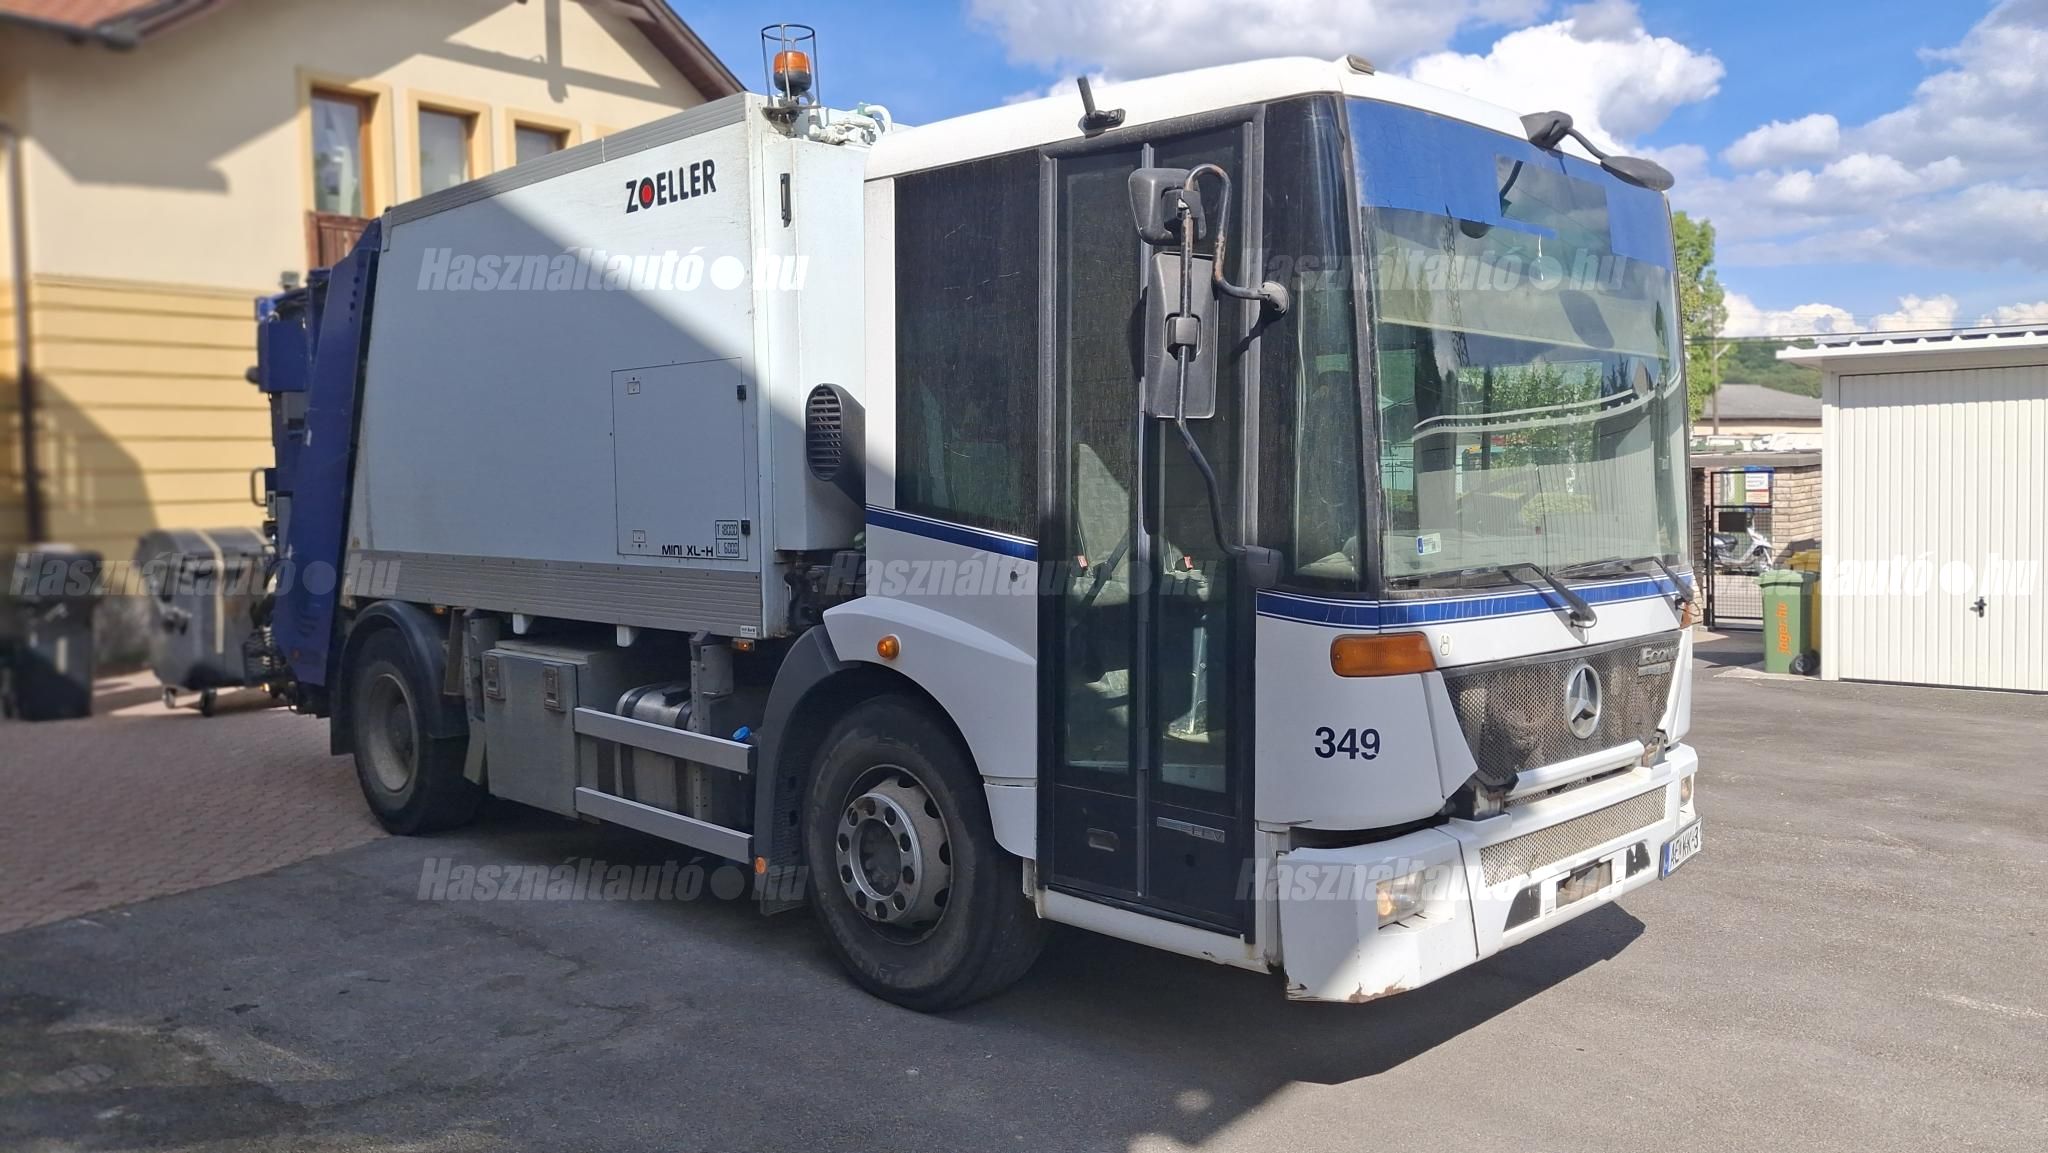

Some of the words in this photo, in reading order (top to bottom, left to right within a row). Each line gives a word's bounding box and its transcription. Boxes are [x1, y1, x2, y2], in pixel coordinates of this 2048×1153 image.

[626, 159, 717, 214] ZOELLER
[661, 544, 683, 556] MINI
[686, 544, 714, 557] XL-H
[1314, 726, 1381, 761] 349
